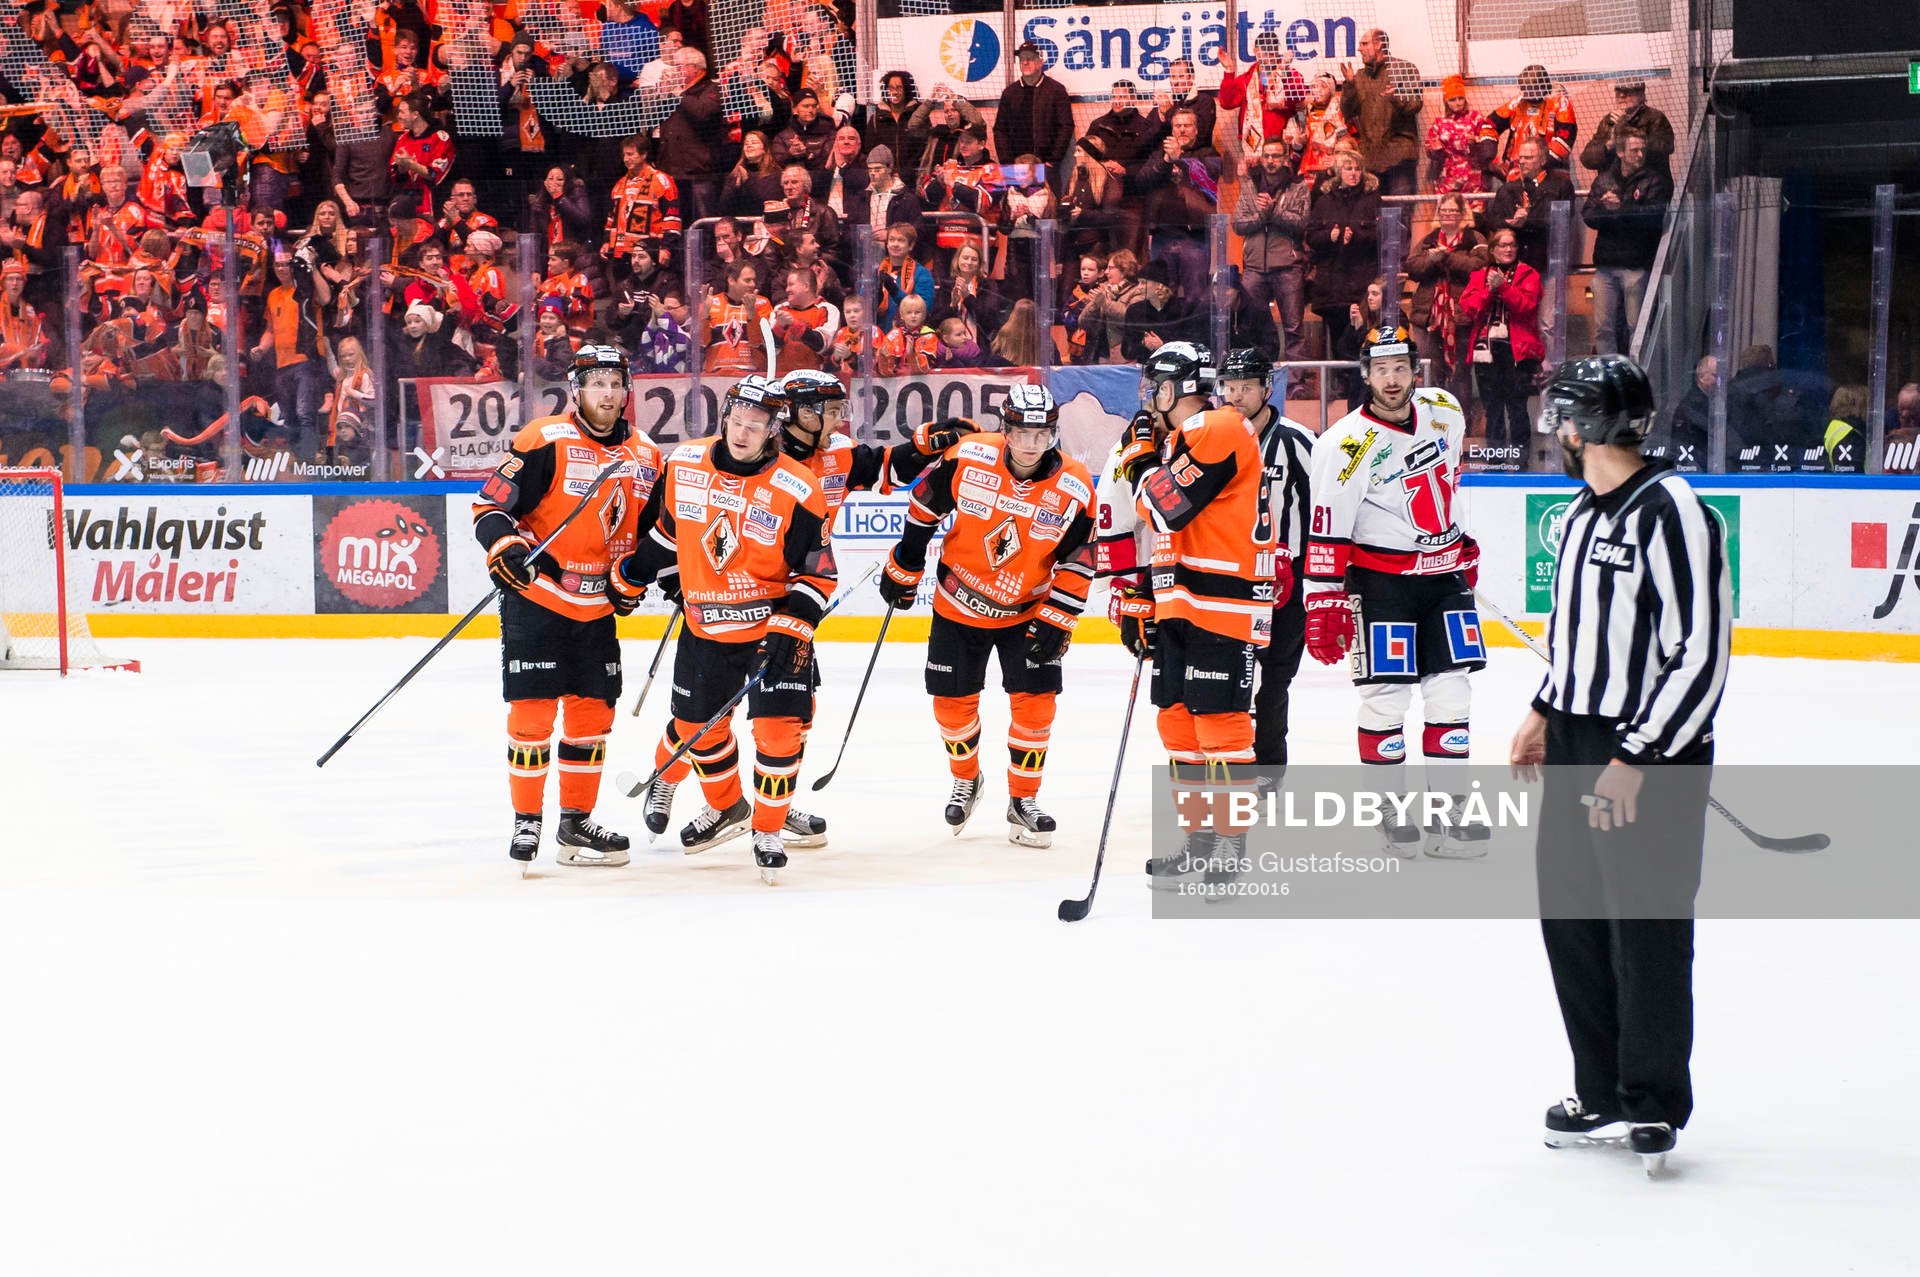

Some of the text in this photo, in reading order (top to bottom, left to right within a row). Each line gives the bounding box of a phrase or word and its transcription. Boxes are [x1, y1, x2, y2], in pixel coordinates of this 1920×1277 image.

[1022, 9, 1357, 81] Sängjätten
[857, 381, 1012, 443] 2005
[571, 449, 595, 462] SAVE
[1469, 444, 1520, 461] Experis
[293, 461, 368, 479] Manpower
[677, 469, 704, 483] SAVE
[1170, 453, 1204, 488] 85
[1265, 466, 1282, 479] HL
[1469, 463, 1520, 472] ManpowerGroup
[569, 481, 590, 490] BAG
[783, 475, 808, 495] STENA
[967, 470, 998, 487] SAVE
[1148, 468, 1183, 512] ABB
[961, 500, 988, 514] BAGA
[1001, 499, 1028, 514] jalas
[1312, 505, 1331, 535] 81
[47, 507, 266, 557] Wahlqvist
[1592, 541, 1633, 567] SHL
[91, 552, 239, 603] Måleri
[337, 567, 416, 591] MEGAPOL
[953, 563, 1015, 604] printfabrike
[687, 586, 768, 602] printfabriken
[703, 605, 772, 623] BILCENTER
[522, 661, 557, 671] Roxtec
[1194, 669, 1230, 681] Roxtec
[1240, 643, 1255, 689] Swede
